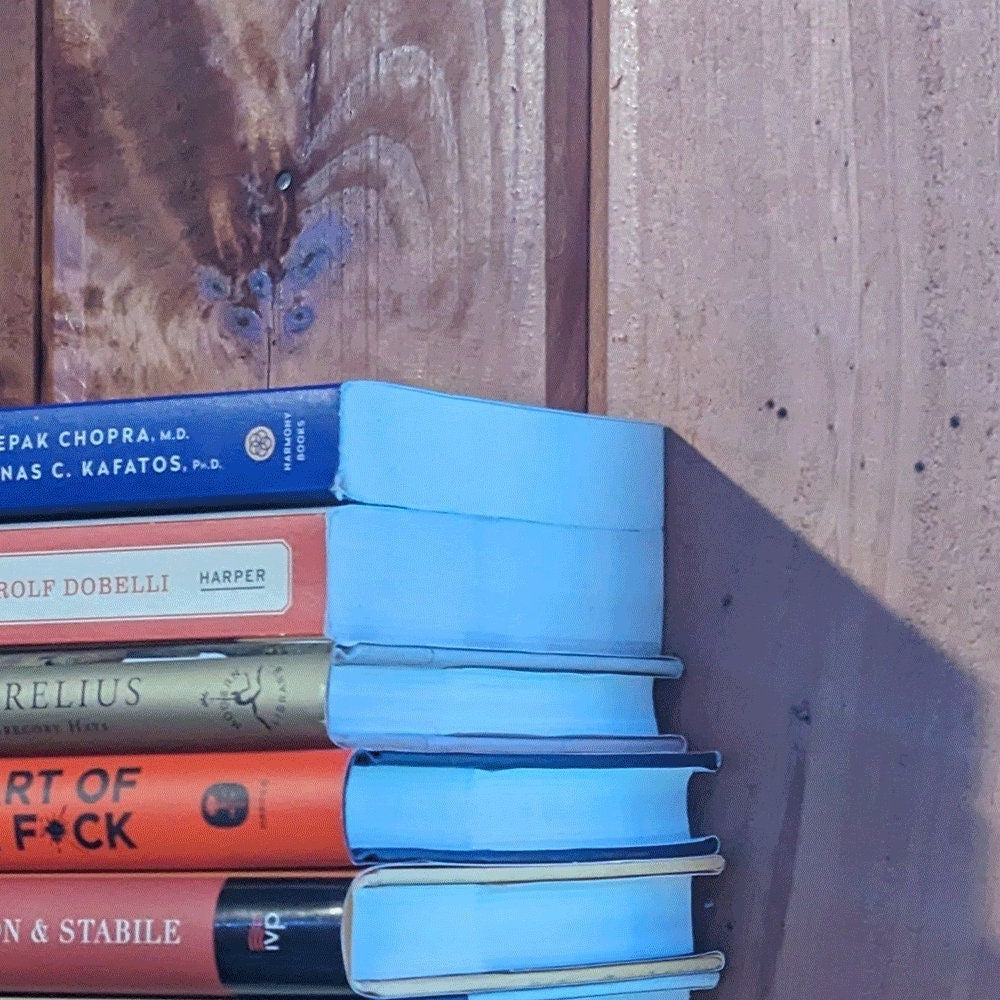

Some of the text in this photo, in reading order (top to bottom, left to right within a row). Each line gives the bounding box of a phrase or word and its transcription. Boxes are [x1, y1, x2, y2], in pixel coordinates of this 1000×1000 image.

[58, 428, 155, 447] CHOPRA,
[160, 428, 190, 441] M.D.
[284, 412, 292, 471] HARMONY
[296, 420, 305, 461] BOOKS
[51, 463, 71, 478] C.
[81, 455, 187, 477] KAFATOS,
[63, 575, 170, 597] DOBELLI
[200, 569, 266, 584] HARPER
[76, 766, 142, 803] OF
[31, 920, 48, 943] &
[59, 918, 181, 944] STABILE
